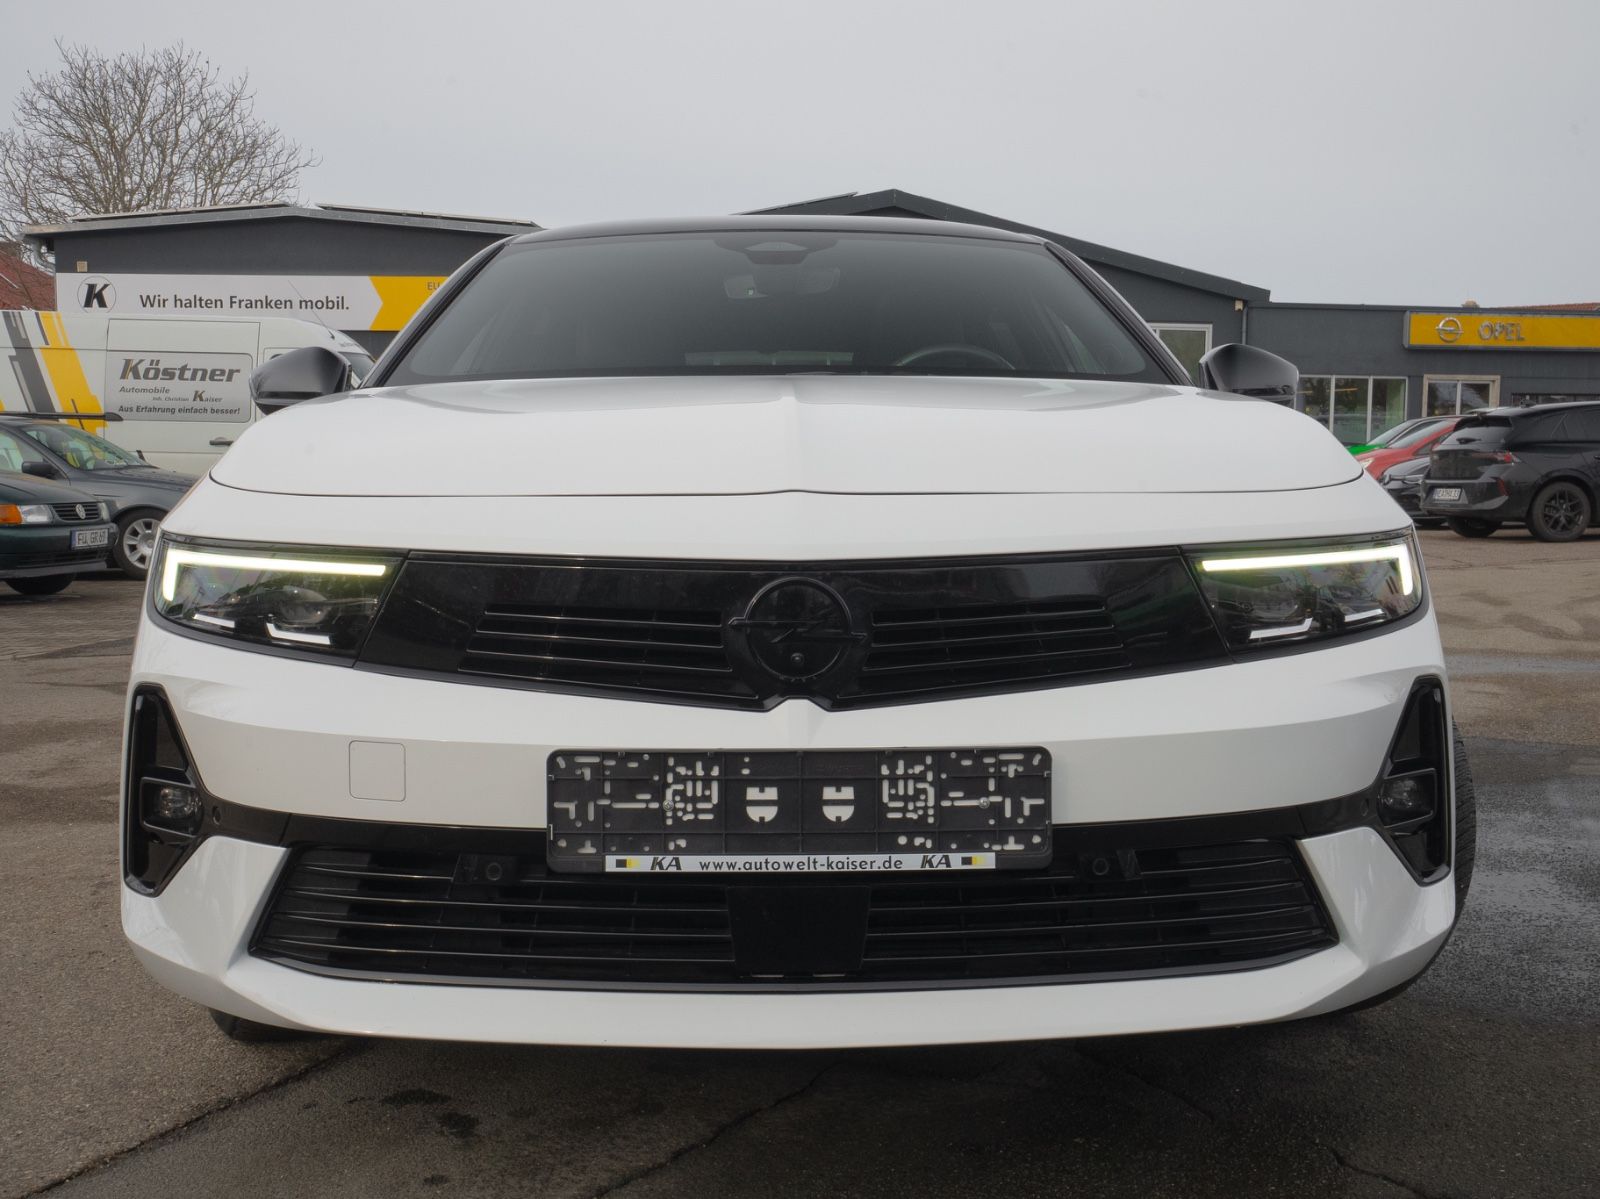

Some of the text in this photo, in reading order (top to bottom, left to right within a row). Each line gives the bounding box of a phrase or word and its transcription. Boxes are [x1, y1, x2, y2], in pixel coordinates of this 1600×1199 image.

[139, 294, 350, 310] Wir halten Franken mobil.
[1478, 321, 1526, 341] OPEL
[119, 358, 241, 383] Köstner
[119, 386, 170, 395] Automobile
[192, 390, 223, 403] Kaiser
[118, 405, 241, 415] Aus Erfahrung einfach besser!
[650, 854, 952, 872] KA www.autowelt-kaiser.de KA
